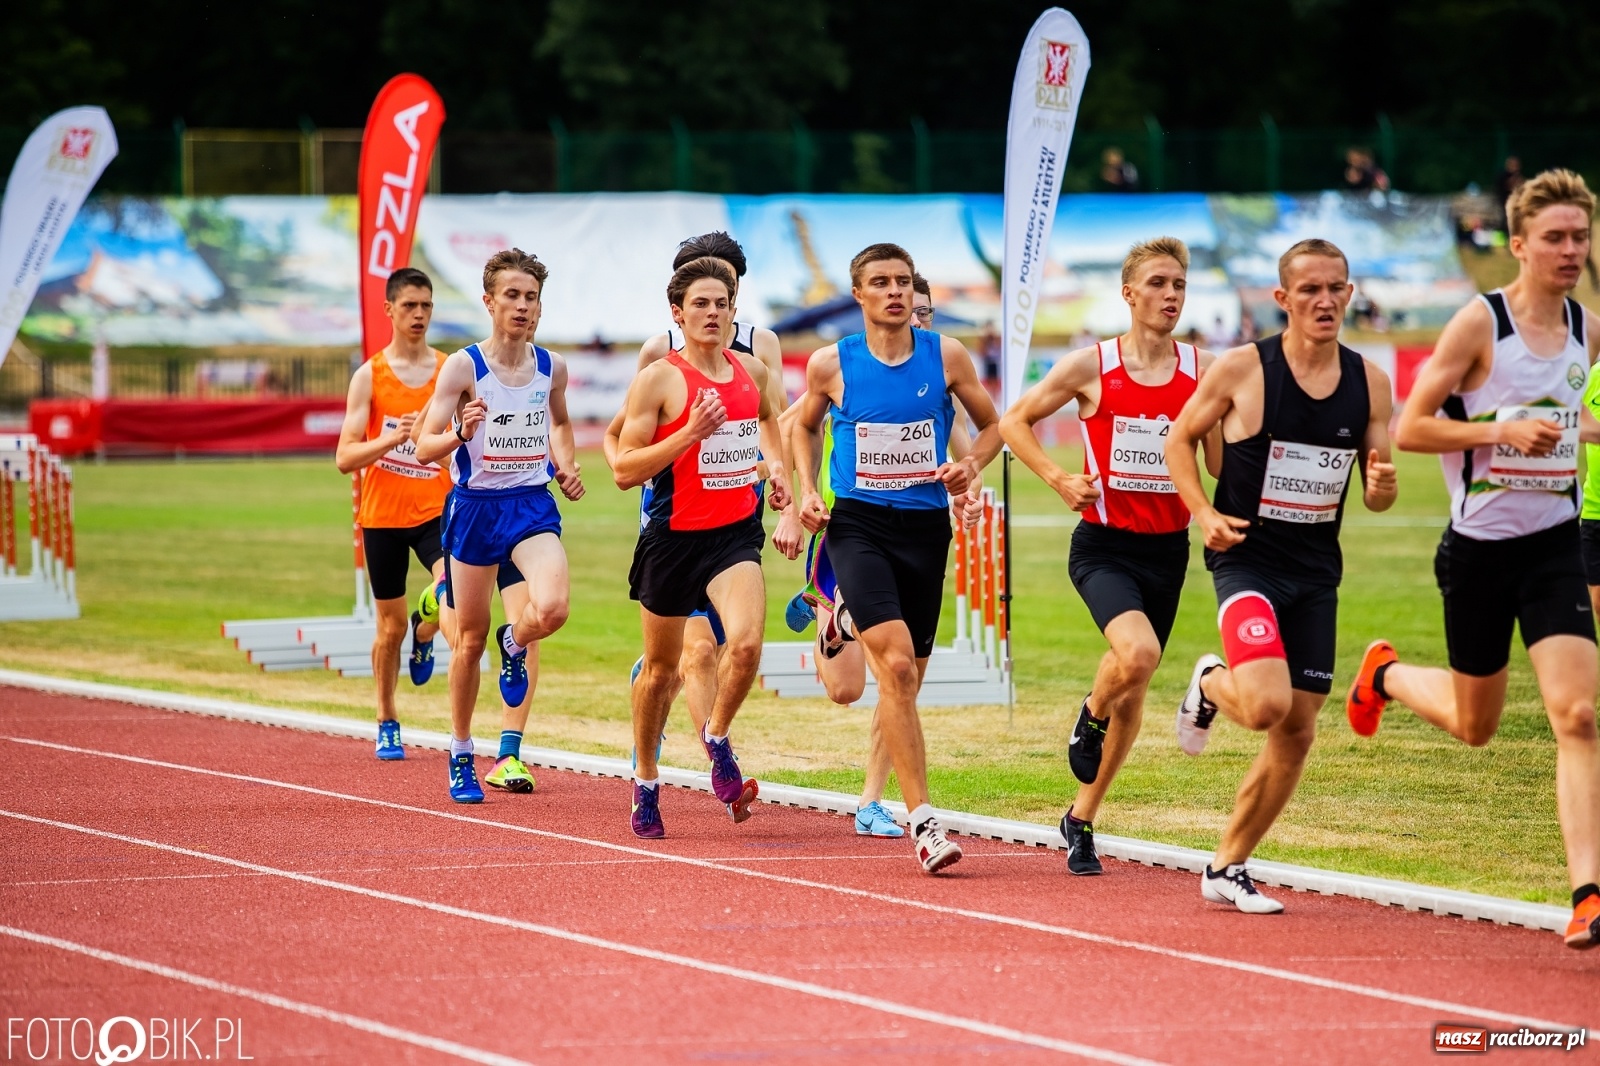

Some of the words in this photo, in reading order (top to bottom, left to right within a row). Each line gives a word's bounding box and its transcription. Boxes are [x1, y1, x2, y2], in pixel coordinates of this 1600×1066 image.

[368, 101, 429, 280] PZLA
[1020, 209, 1036, 283] POLSKIEGO
[1011, 289, 1032, 349] 100
[493, 413, 515, 426] 4F
[525, 410, 545, 427] 137
[1551, 411, 1579, 429] 211
[738, 420, 758, 438] 369
[900, 422, 932, 442] 260
[1158, 424, 1170, 437] 4
[488, 434, 545, 449] WIATRZYK
[701, 446, 759, 465] GUŻKOWSKI
[860, 449, 933, 466] BIERNACKI
[1318, 451, 1353, 470] 367
[381, 462, 414, 476] RACIBÓRZ
[490, 462, 525, 470] RACIBÓRZ
[526, 462, 541, 470] 2019
[706, 478, 742, 488] RACIBÓRZ
[865, 479, 907, 490] RACIBÓRZ
[1116, 480, 1159, 491] RACIBÓRZ
[1269, 475, 1344, 496] TERESZKIEWICZ
[1270, 508, 1314, 521] RACIBÓRZ
